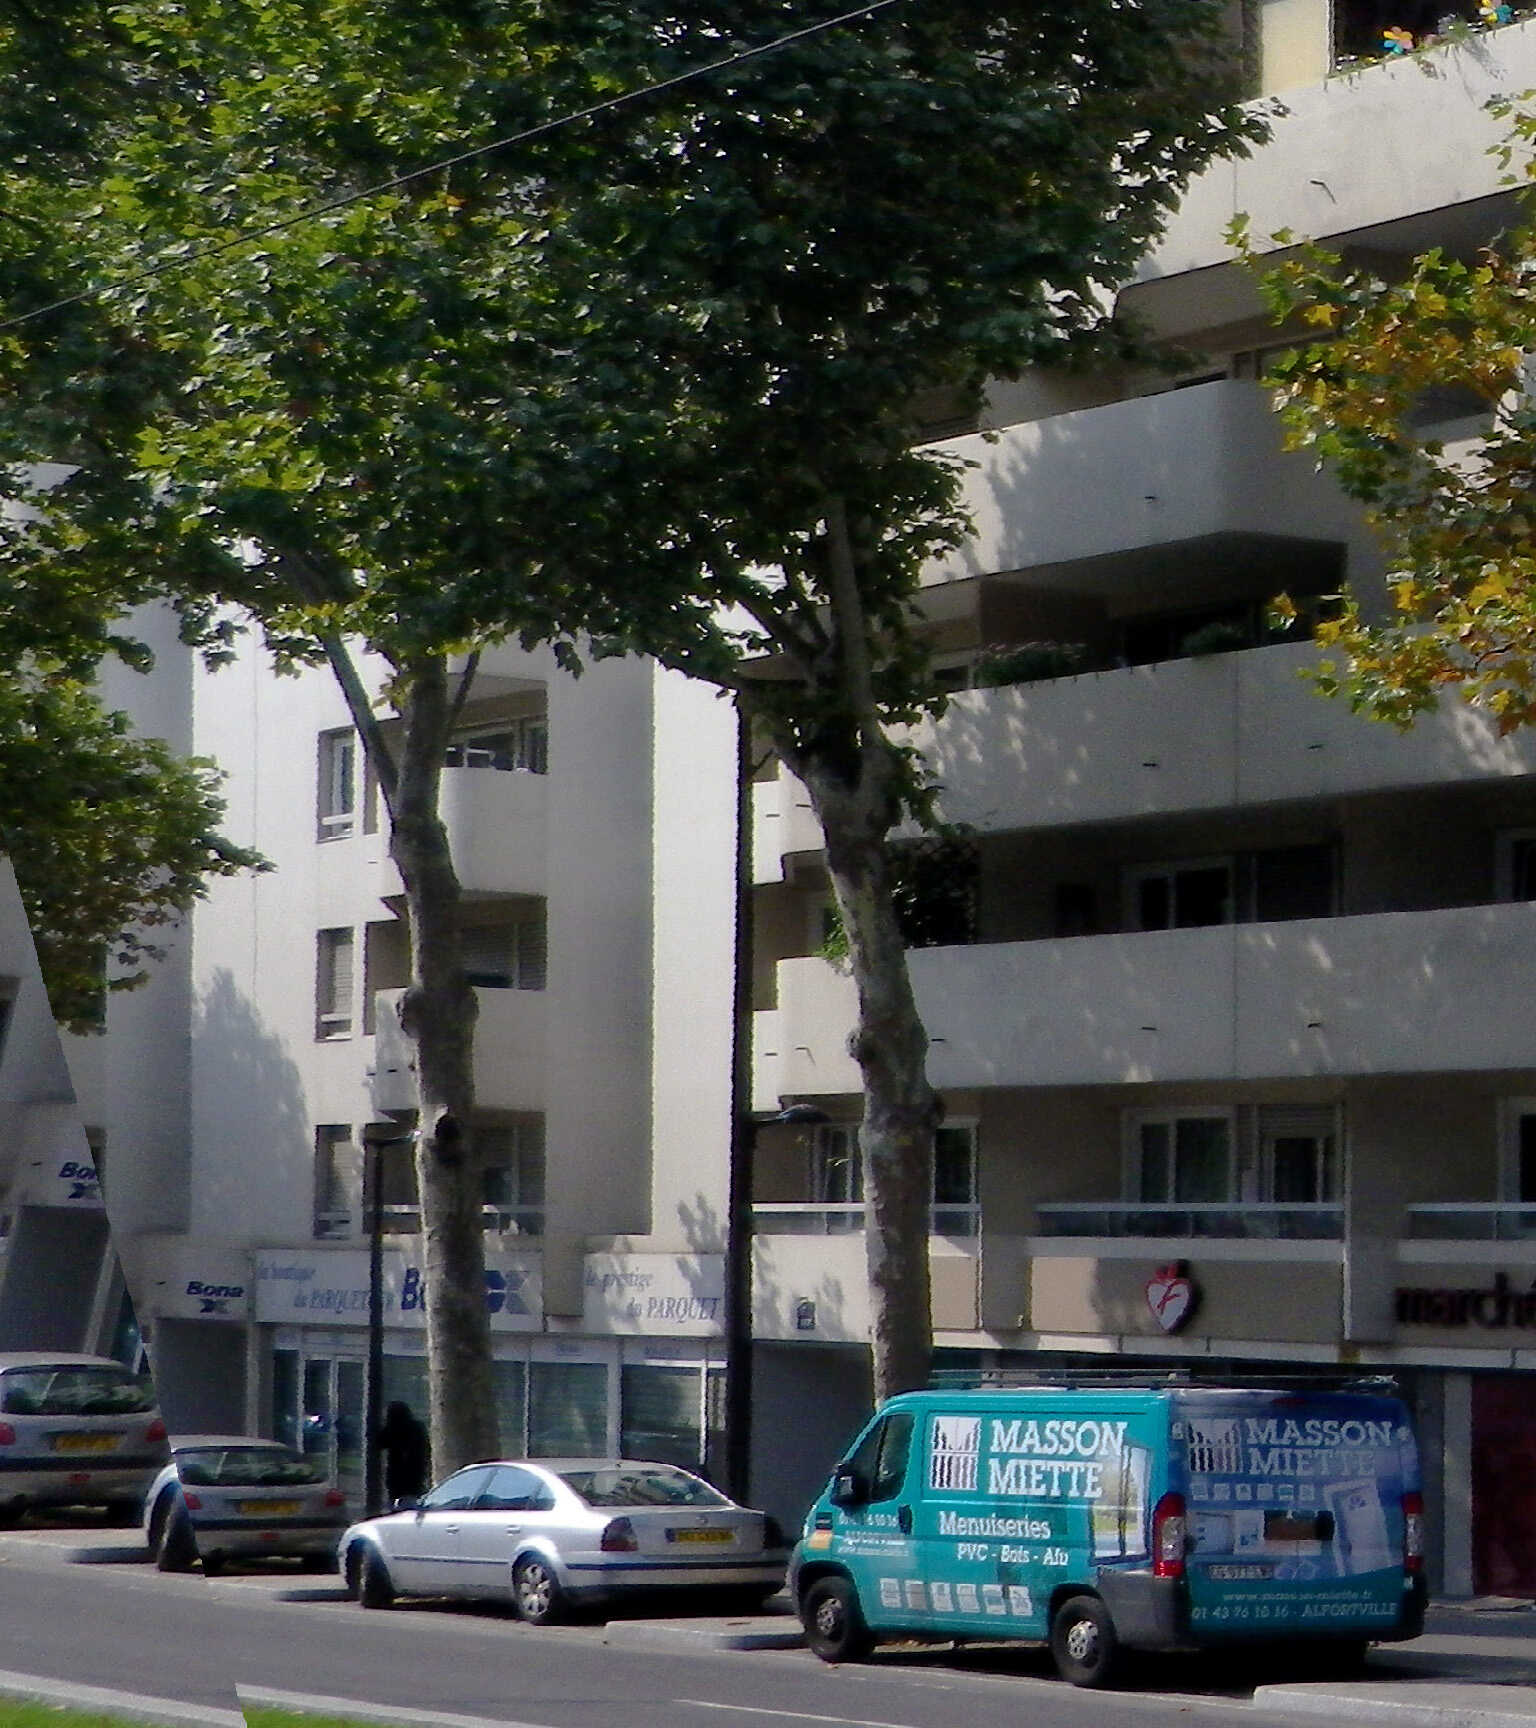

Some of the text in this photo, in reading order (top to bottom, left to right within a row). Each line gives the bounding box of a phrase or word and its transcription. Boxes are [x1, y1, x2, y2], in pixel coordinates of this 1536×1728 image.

[186, 1282, 244, 1298] Bona
[647, 1297, 720, 1323] PARQUET
[990, 1420, 1128, 1456] MASSON
[1246, 1419, 1392, 1446] MASSON
[1249, 1448, 1375, 1476] MIETTE
[988, 1458, 1103, 1498] MIETTE
[938, 1510, 1051, 1539] Menuiseries
[957, 1543, 988, 1561] PVC
[1001, 1545, 1030, 1563] Bois
[1043, 1547, 1069, 1566] Alu
[1302, 1603, 1397, 1618] ALFORTVILLE
